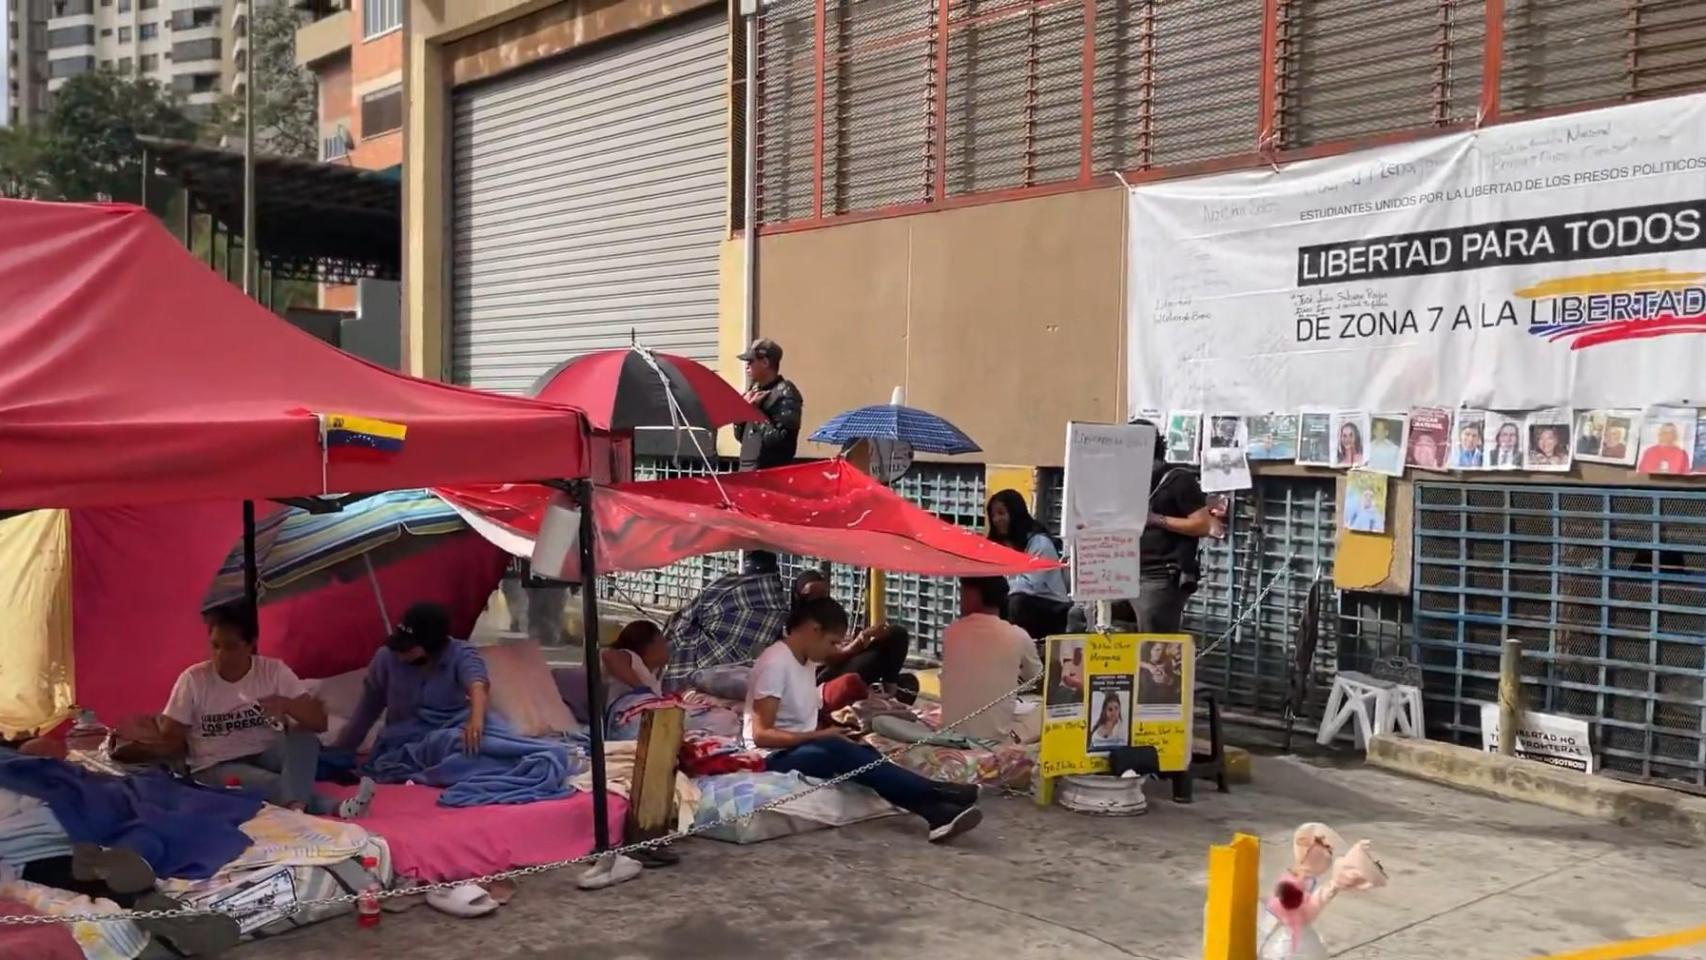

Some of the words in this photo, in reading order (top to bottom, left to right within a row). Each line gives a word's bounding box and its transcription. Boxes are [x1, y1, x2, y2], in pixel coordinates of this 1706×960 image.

[1300, 202, 1373, 221] ESTUDIANTES
[1375, 197, 1417, 211] UNIDOS
[1418, 190, 1444, 205] POR
[1446, 188, 1462, 200] LA
[1464, 180, 1523, 199] LIBERTAD
[1525, 178, 1543, 190] DE
[1545, 174, 1571, 188] LOS
[1573, 166, 1629, 184] PRESOS
[1632, 156, 1706, 178] POLITICOS
[1303, 237, 1452, 280] LIBERTAD
[1461, 225, 1555, 262] PARA
[1564, 209, 1701, 251] TODOS
[1296, 316, 1331, 342] DE
[1338, 309, 1419, 339] ZONA
[1427, 306, 1444, 332] 7
[1451, 304, 1472, 331] A
[1481, 299, 1518, 328] LA
[1530, 287, 1706, 325] LIBERTAD
[201, 723, 223, 732] LOS
[226, 716, 265, 731] PRESO
